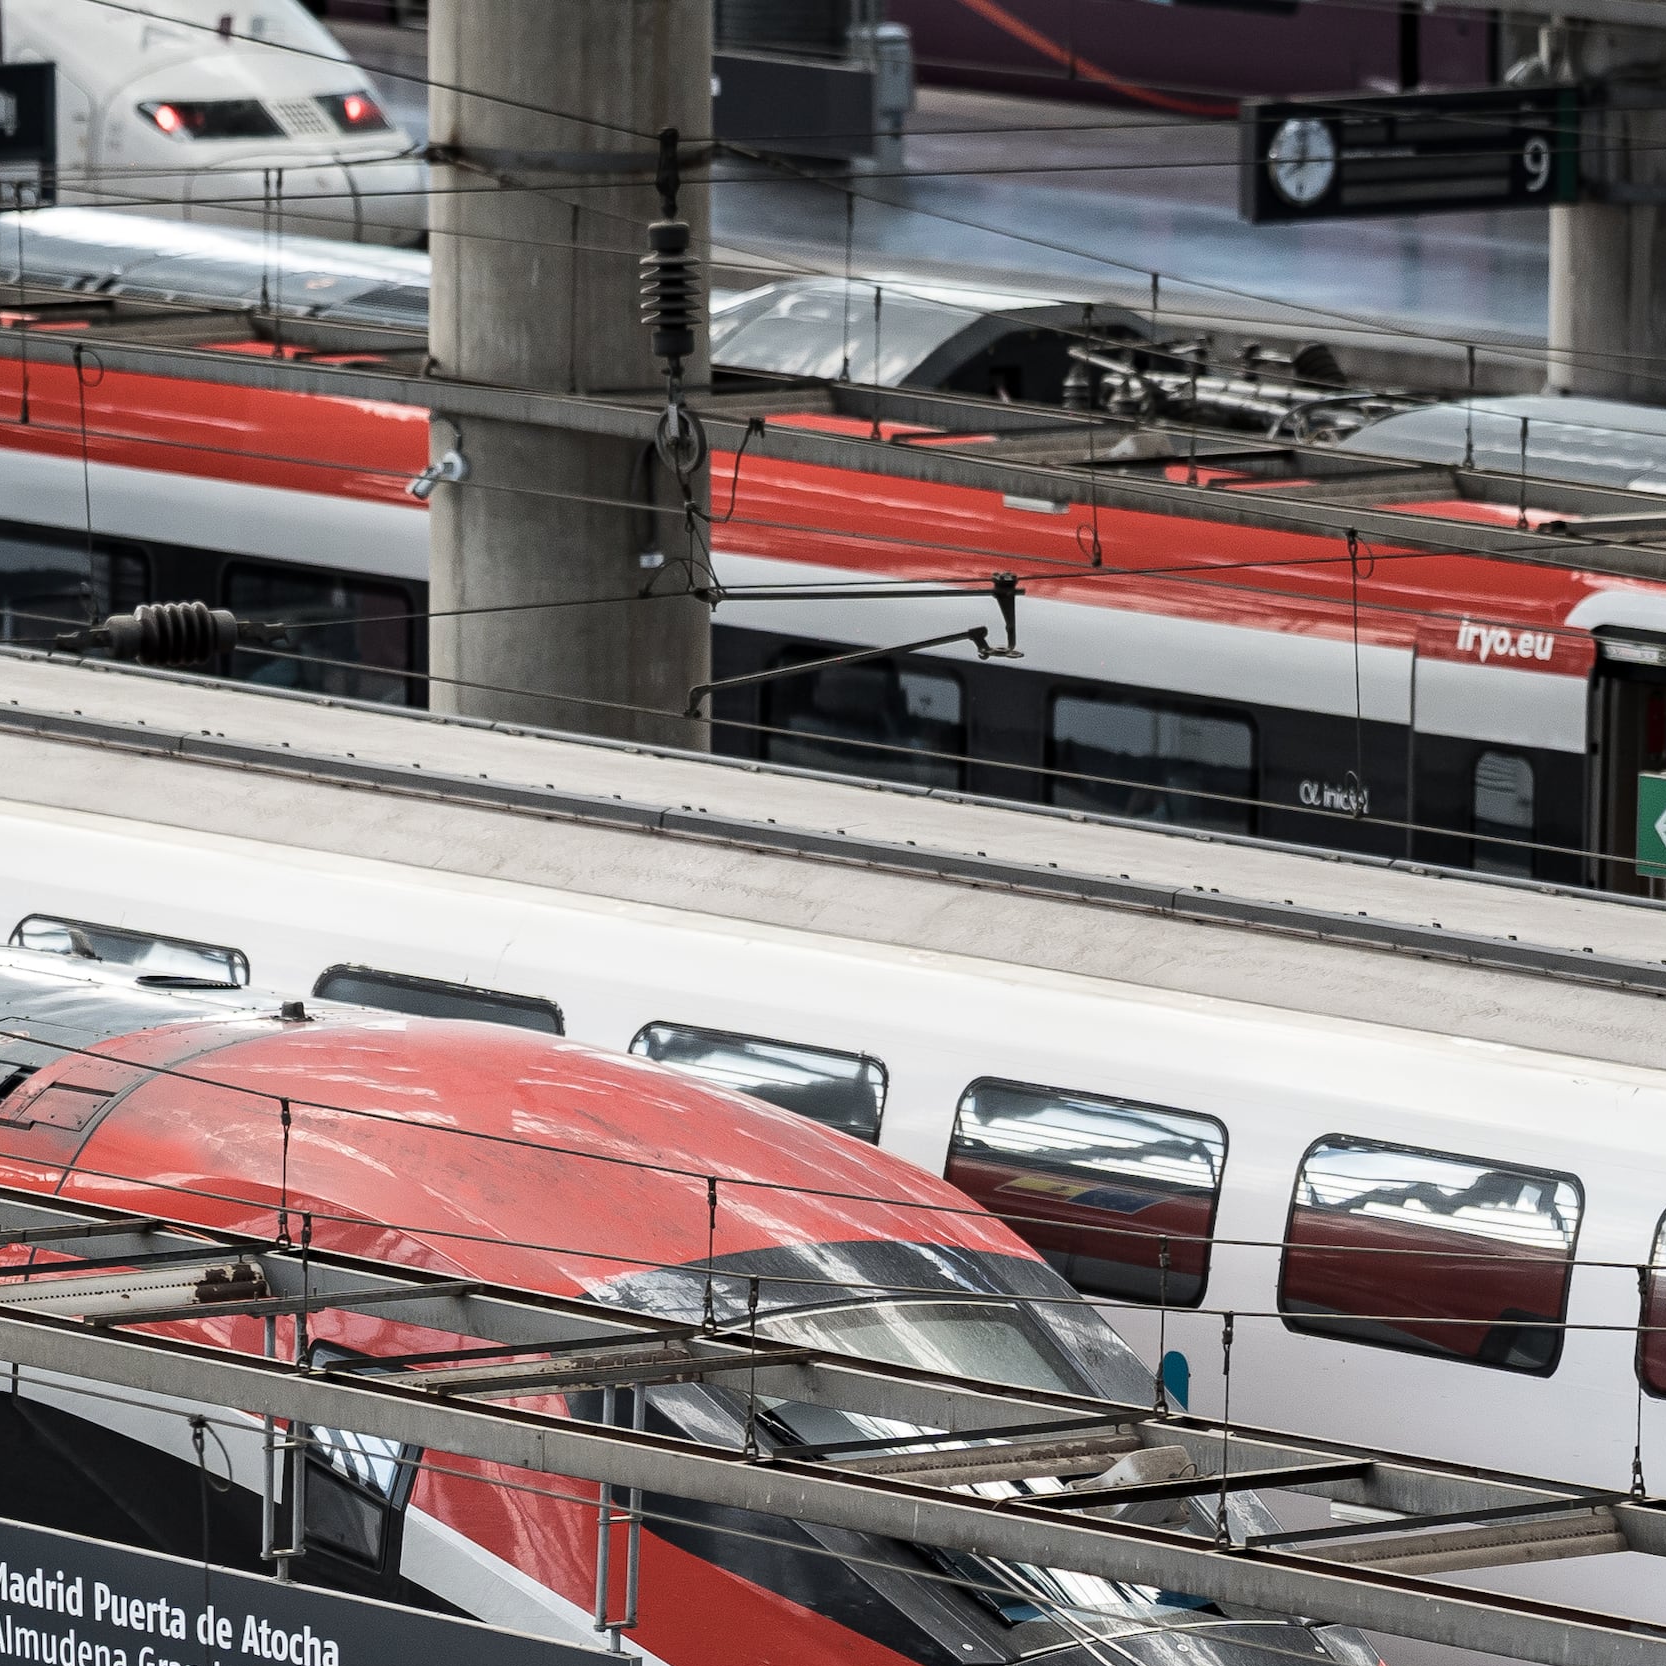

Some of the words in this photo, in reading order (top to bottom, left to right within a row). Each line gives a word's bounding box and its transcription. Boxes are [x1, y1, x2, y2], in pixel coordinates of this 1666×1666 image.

[1523, 136, 1551, 192] 9
[1457, 615, 1555, 663] iryo.eu
[94, 1581, 186, 1640] Puerta
[196, 1605, 232, 1649] de
